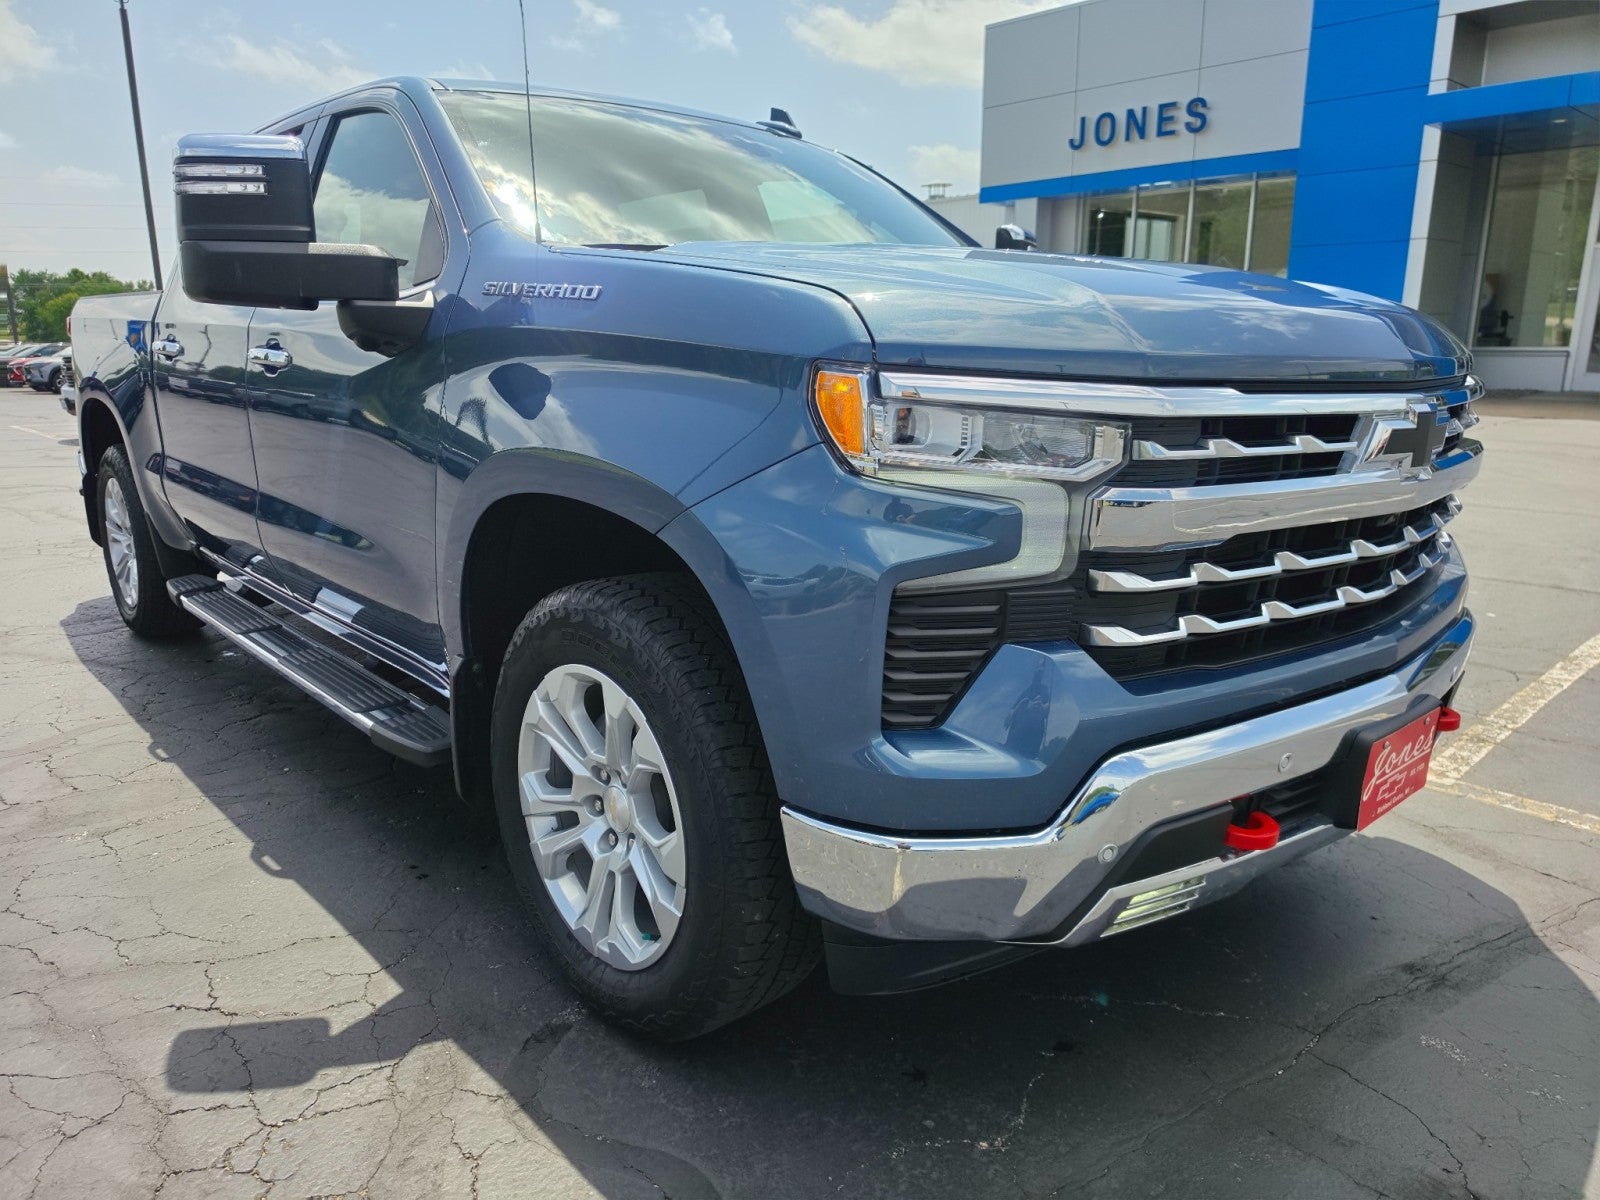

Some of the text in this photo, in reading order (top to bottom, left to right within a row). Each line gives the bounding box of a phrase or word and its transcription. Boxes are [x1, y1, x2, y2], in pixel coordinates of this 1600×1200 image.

[1068, 97, 1208, 150] JONES
[482, 281, 602, 300] SILVERADO
[1362, 725, 1436, 802] Jones
